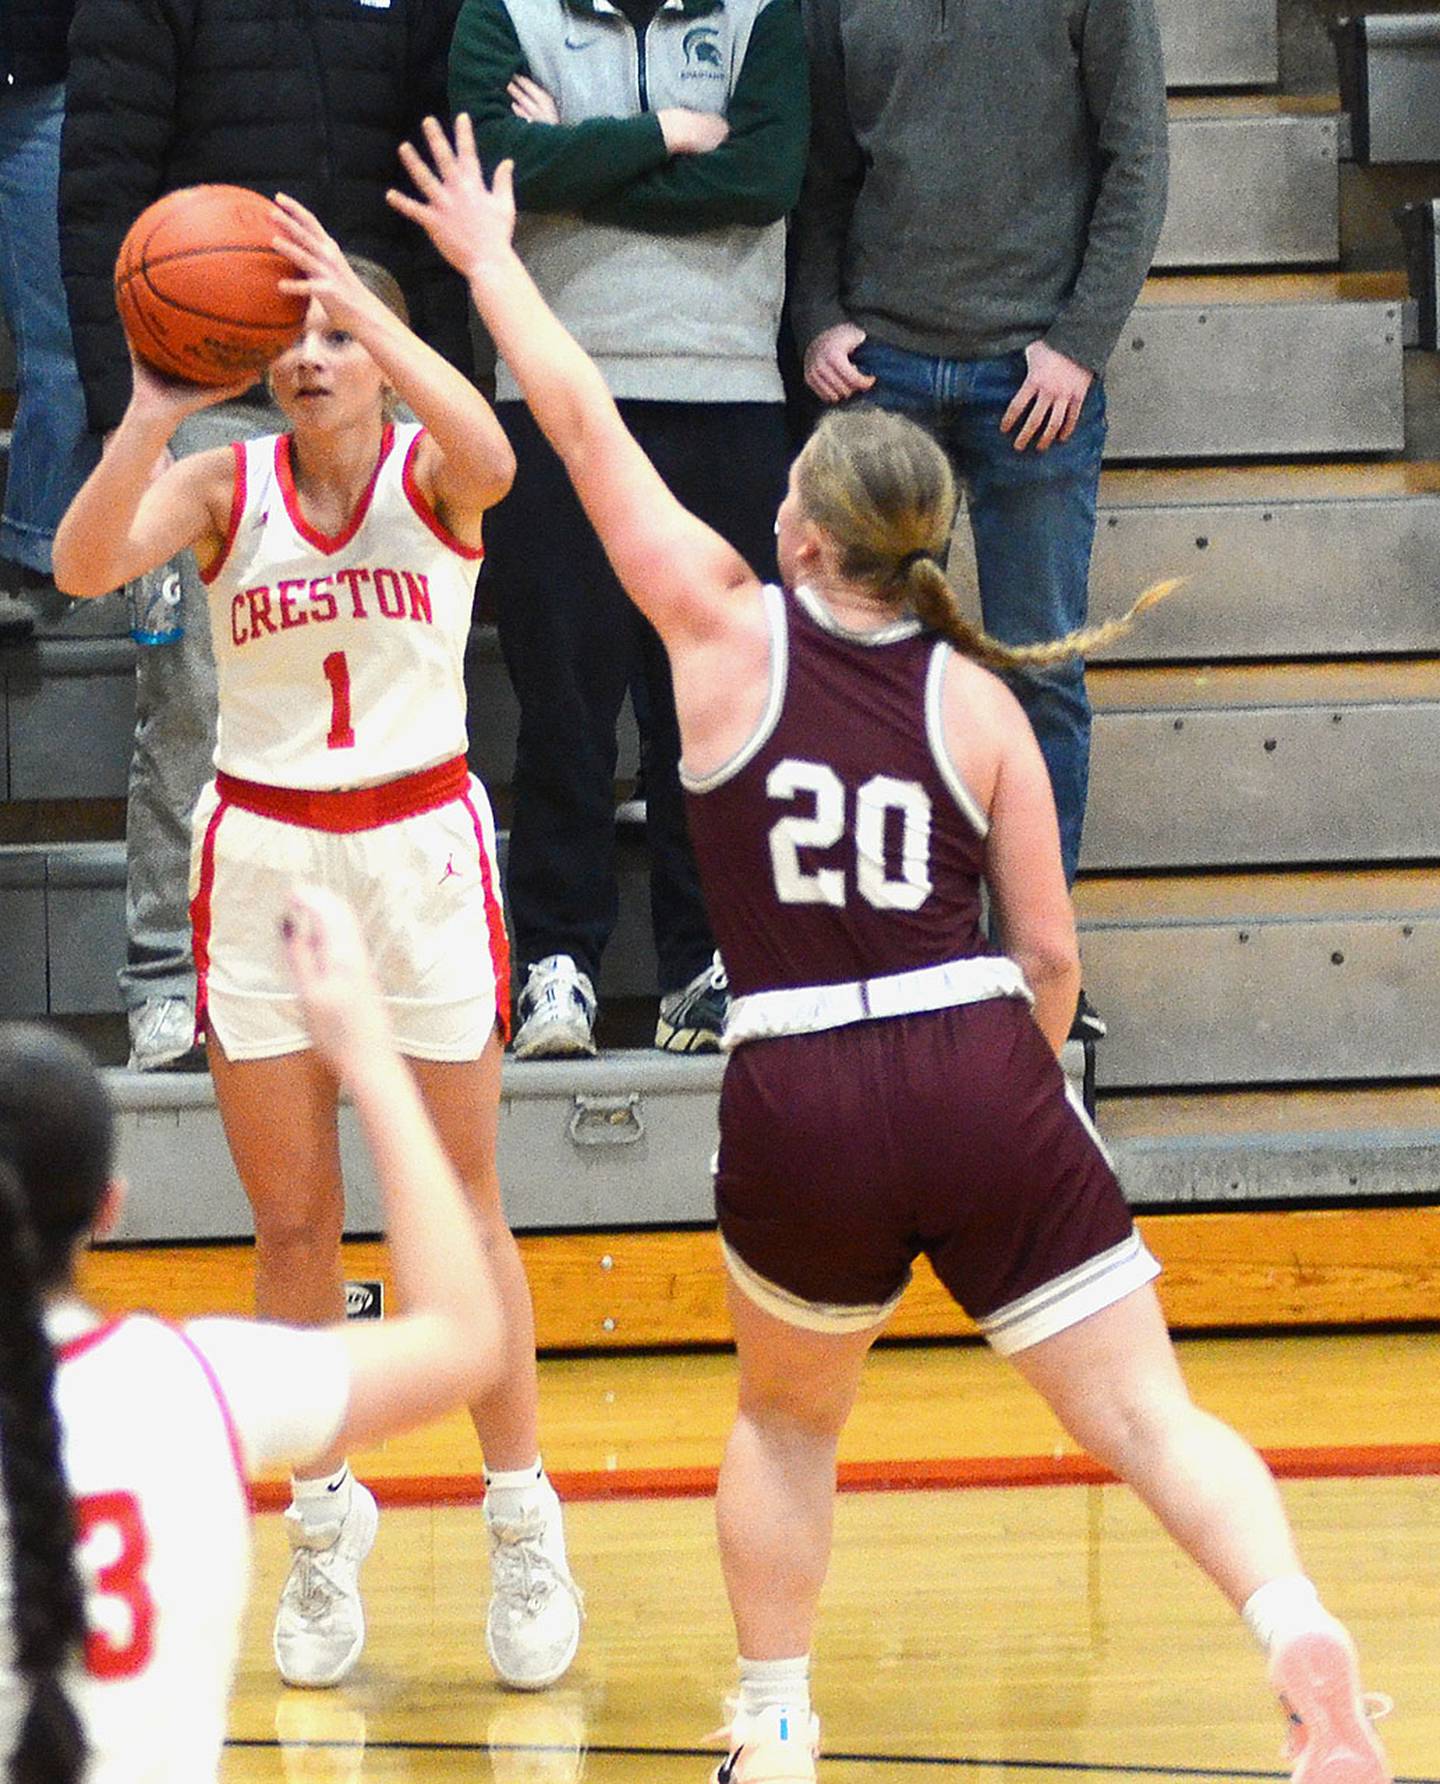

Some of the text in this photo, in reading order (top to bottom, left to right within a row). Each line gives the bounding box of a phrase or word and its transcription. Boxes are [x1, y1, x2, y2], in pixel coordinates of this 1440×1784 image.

[231, 567, 433, 647] CRESTON
[323, 650, 356, 750] 1
[766, 757, 934, 911] 20
[74, 1490, 155, 1681] 3
